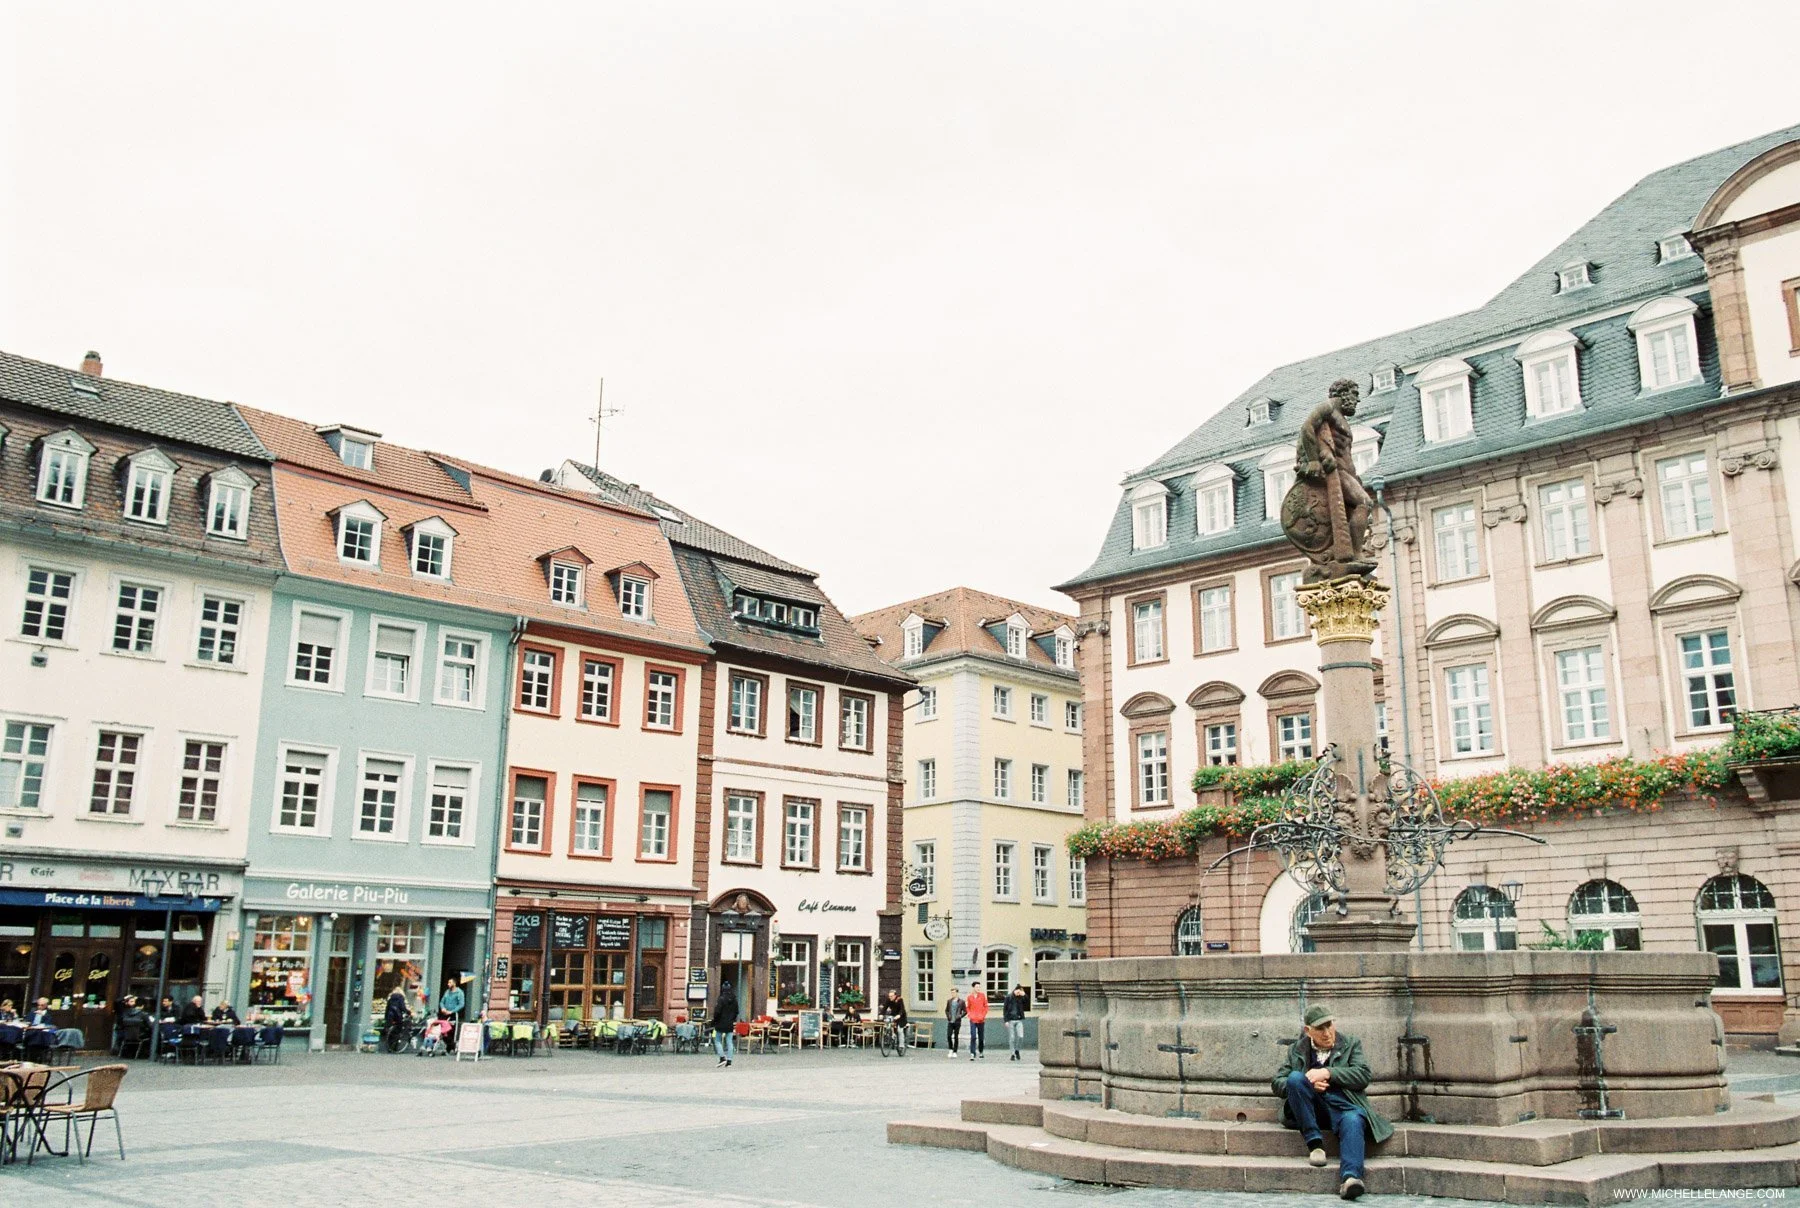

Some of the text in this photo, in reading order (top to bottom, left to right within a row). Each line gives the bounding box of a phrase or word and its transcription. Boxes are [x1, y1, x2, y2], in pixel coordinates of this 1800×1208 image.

[45, 892, 73, 905] Place
[75, 894, 89, 905] de
[91, 895, 101, 906] la
[286, 883, 408, 904] Galerie Piu-Piu
[513, 915, 540, 927] ZKB
